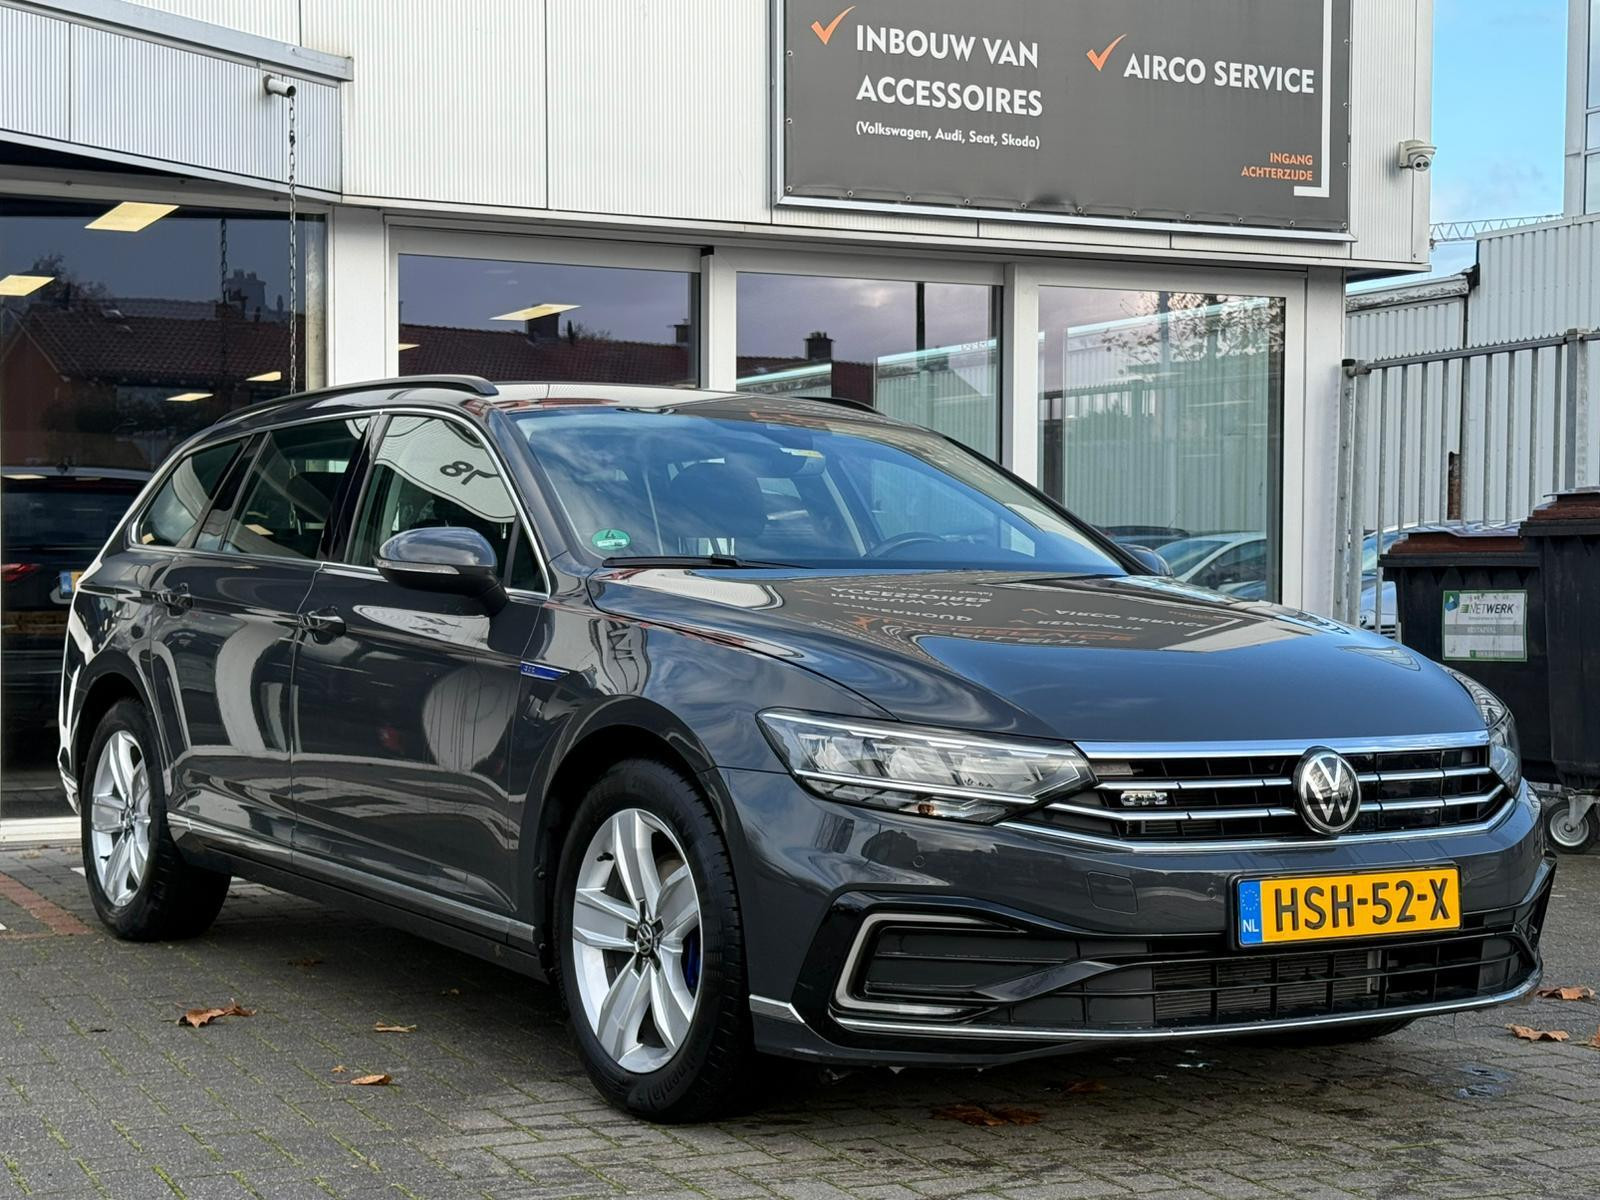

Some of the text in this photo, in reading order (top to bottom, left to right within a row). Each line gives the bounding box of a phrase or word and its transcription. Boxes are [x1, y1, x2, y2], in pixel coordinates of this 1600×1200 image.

[857, 24, 1038, 68] INBOUW VAN
[1123, 53, 1314, 94] AIRCO SERVICE
[856, 74, 1043, 117] ACCESSOIRES
[856, 121, 1040, 150] (Volkswagen, Audi, Seat, Skoda)
[1241, 166, 1313, 181] ACHTERZIJDE
[1269, 152, 1313, 166] INGANG
[1469, 604, 1514, 614] NETWERK
[1275, 878, 1450, 932] HSH-52-X
[1242, 919, 1259, 933] NL
